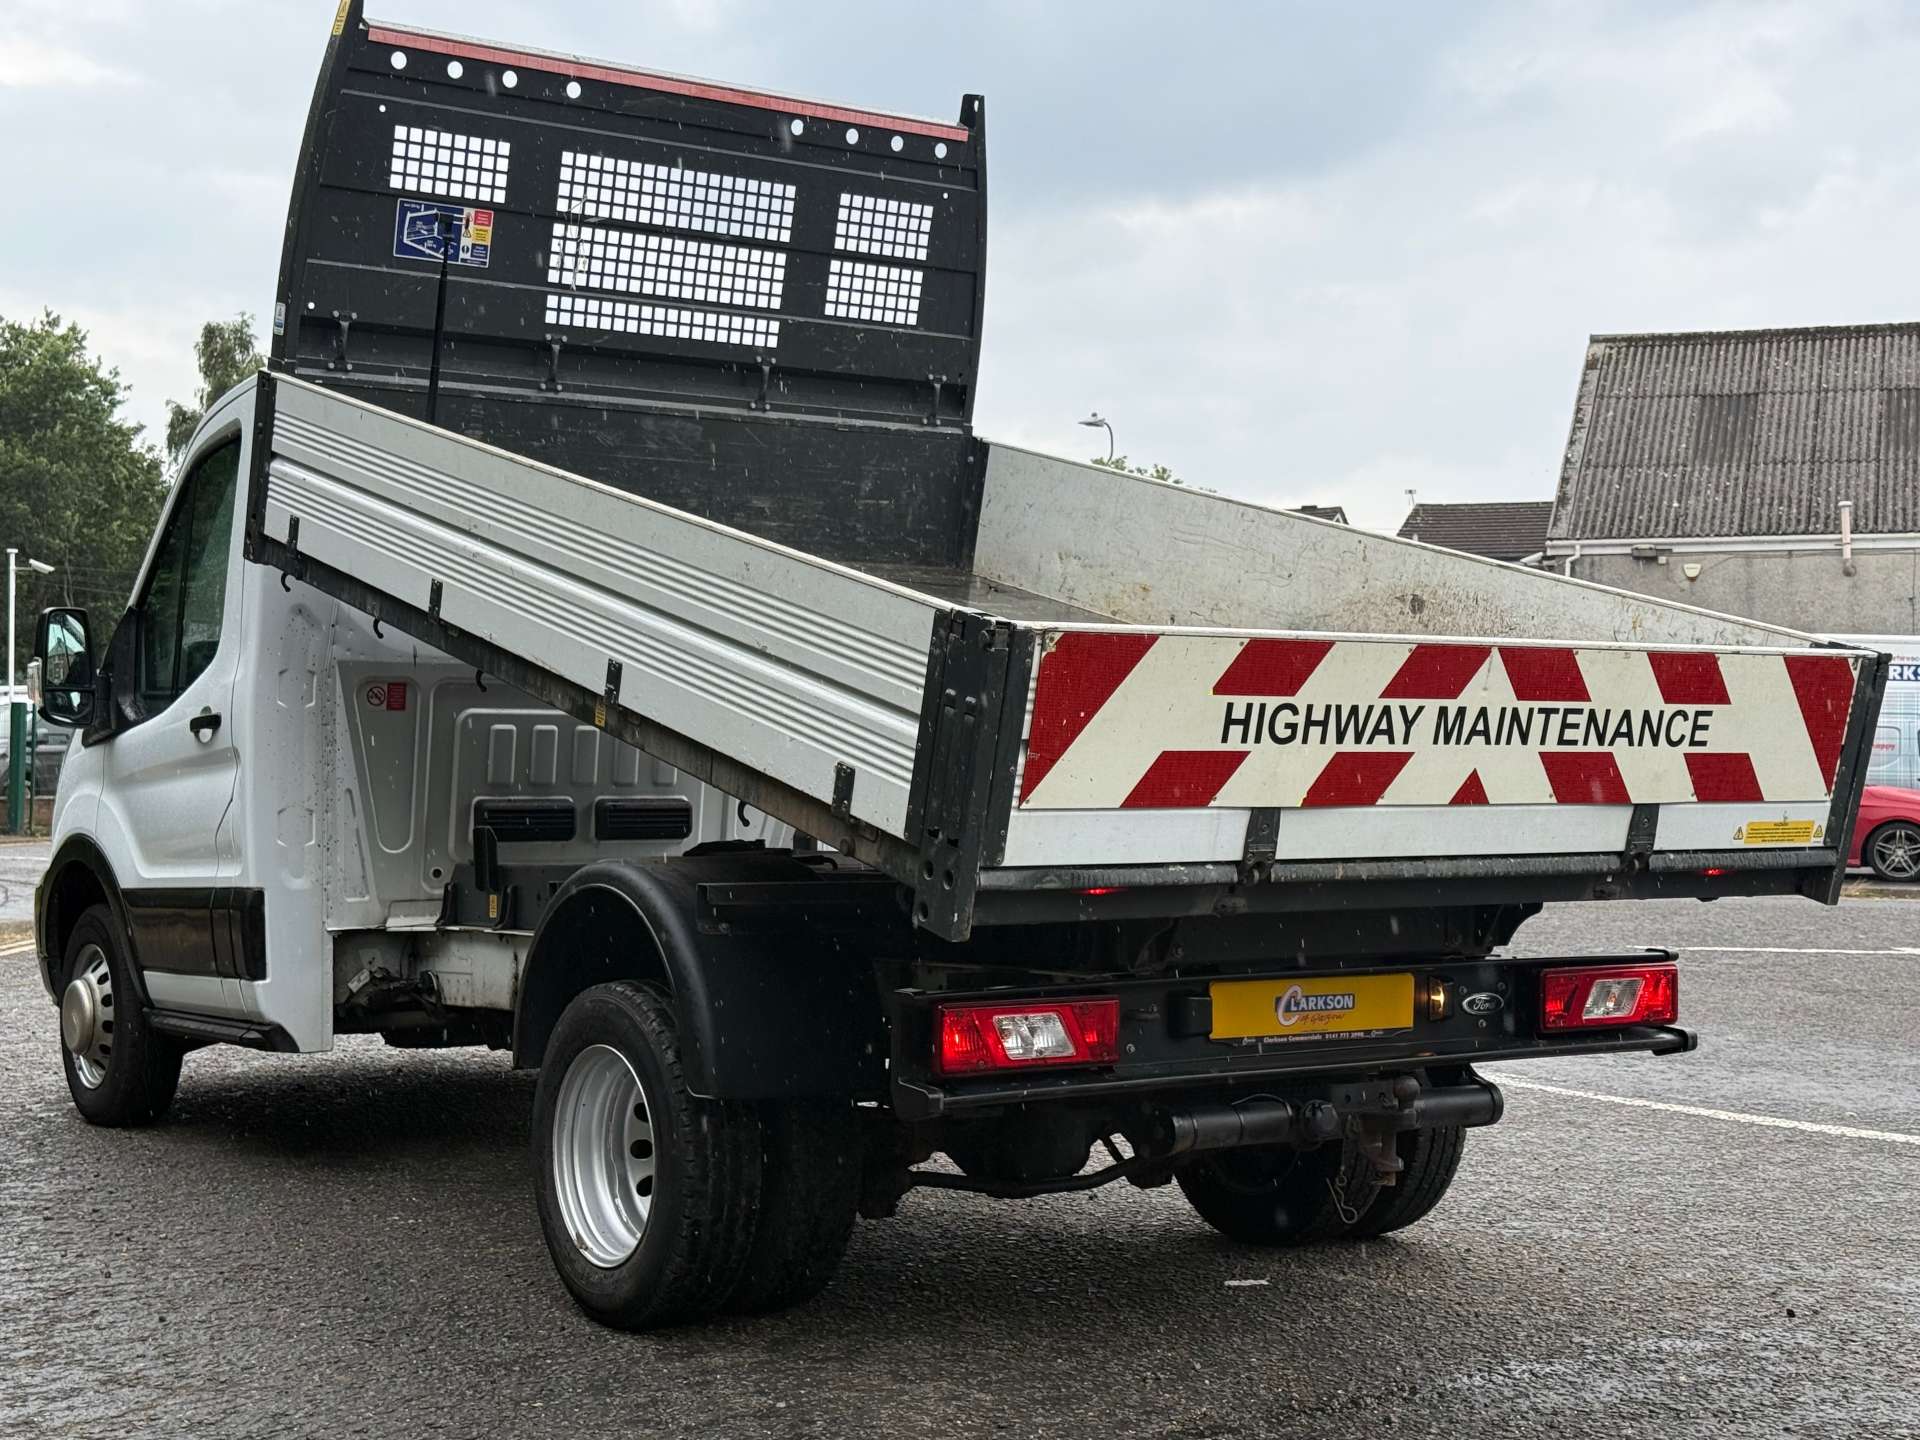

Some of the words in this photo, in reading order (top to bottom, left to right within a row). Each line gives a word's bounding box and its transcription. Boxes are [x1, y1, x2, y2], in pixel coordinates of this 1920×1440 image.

[1220, 702, 1425, 746] HIGHWAY
[1432, 705, 1714, 748] MAINTENANCE
[1277, 984, 1354, 1026] CLARKSON
